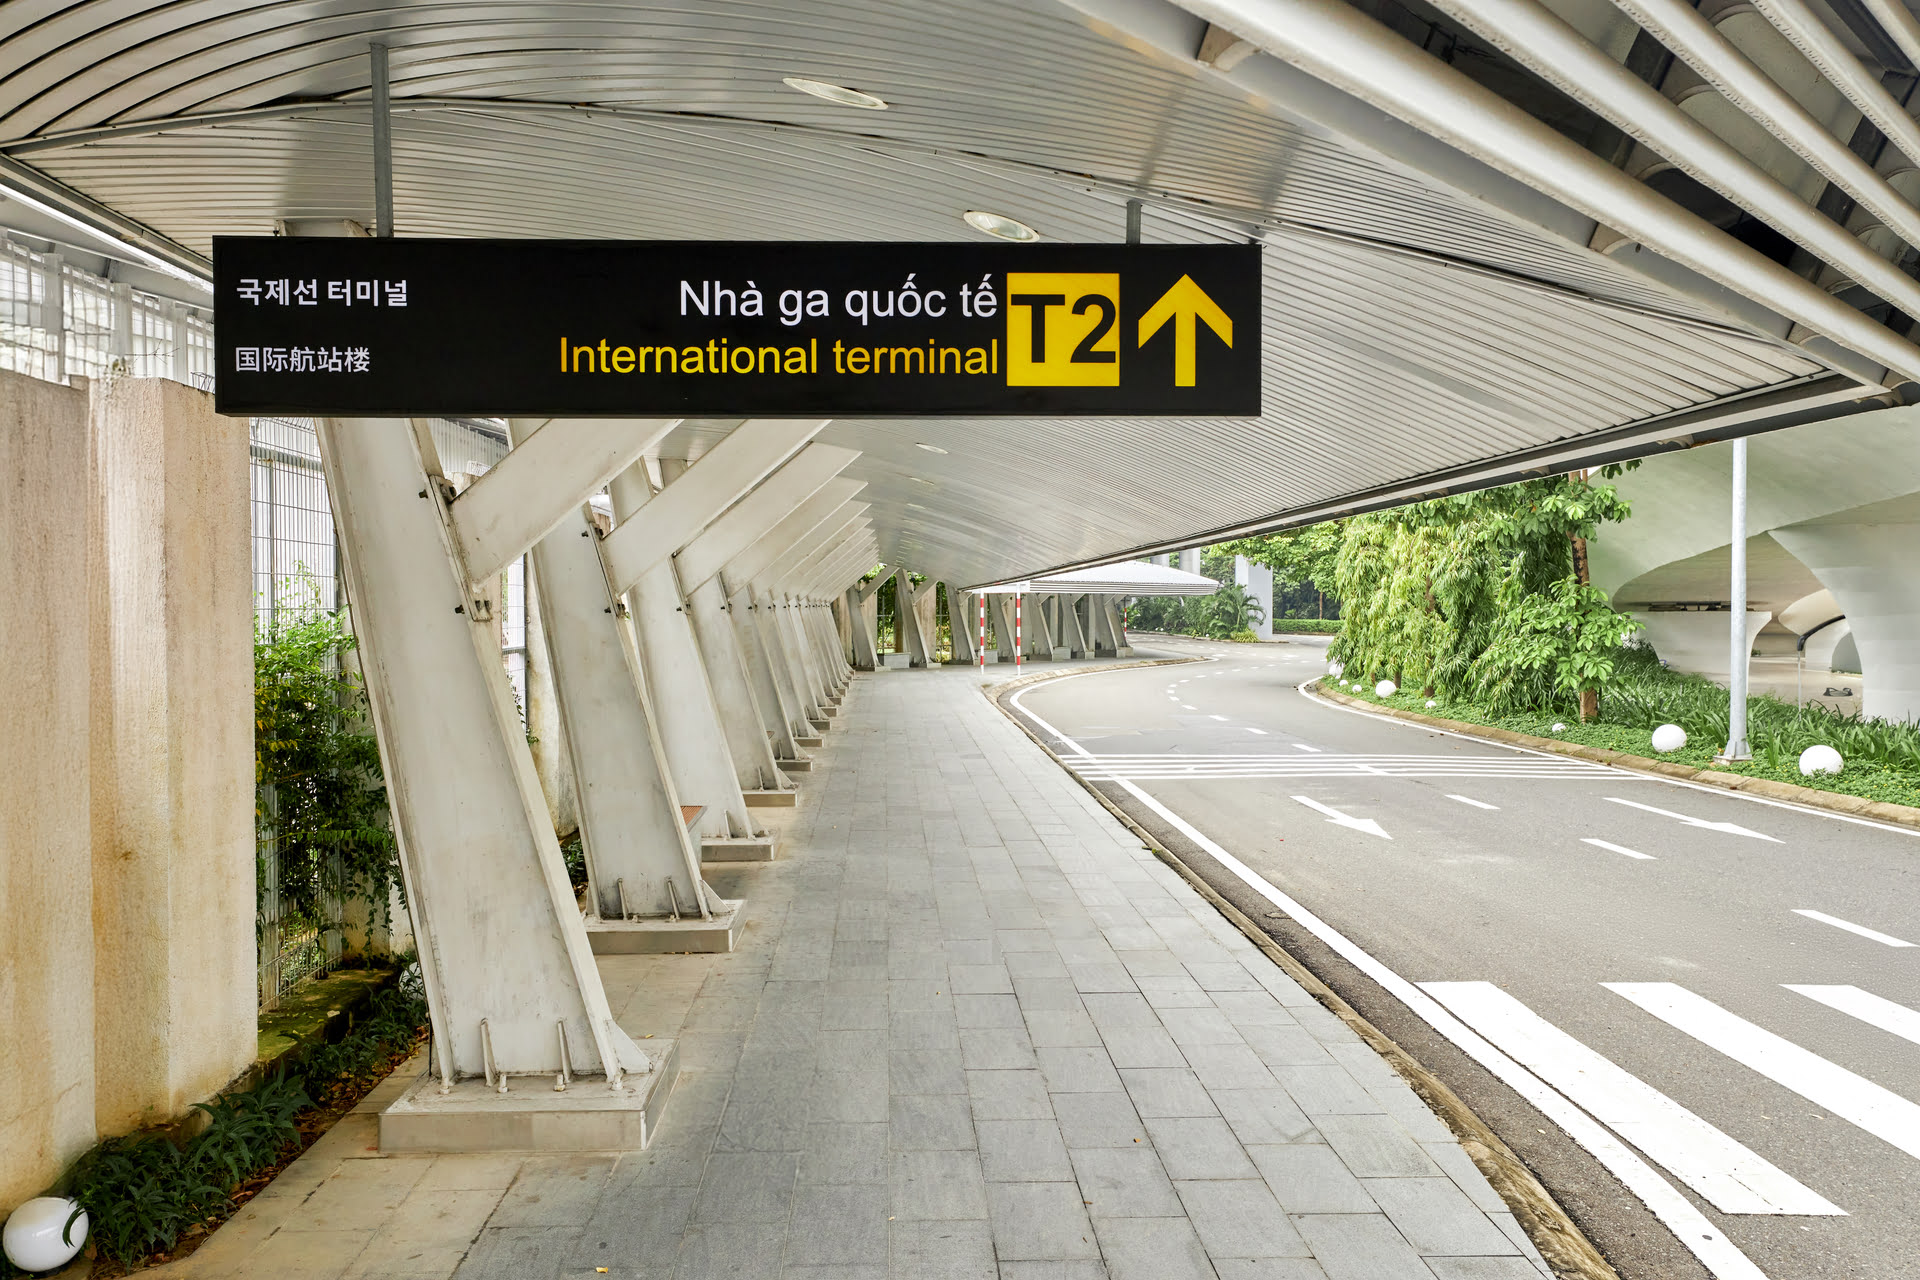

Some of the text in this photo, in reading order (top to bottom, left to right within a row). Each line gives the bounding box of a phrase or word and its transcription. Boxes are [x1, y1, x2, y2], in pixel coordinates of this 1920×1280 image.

[236, 278, 408, 307] 국제선 터미널
[680, 272, 998, 327] Nhà ga quốc tế
[1010, 294, 1117, 364] T2
[235, 346, 370, 373] 国际航站楼
[560, 336, 998, 375] International terminal
